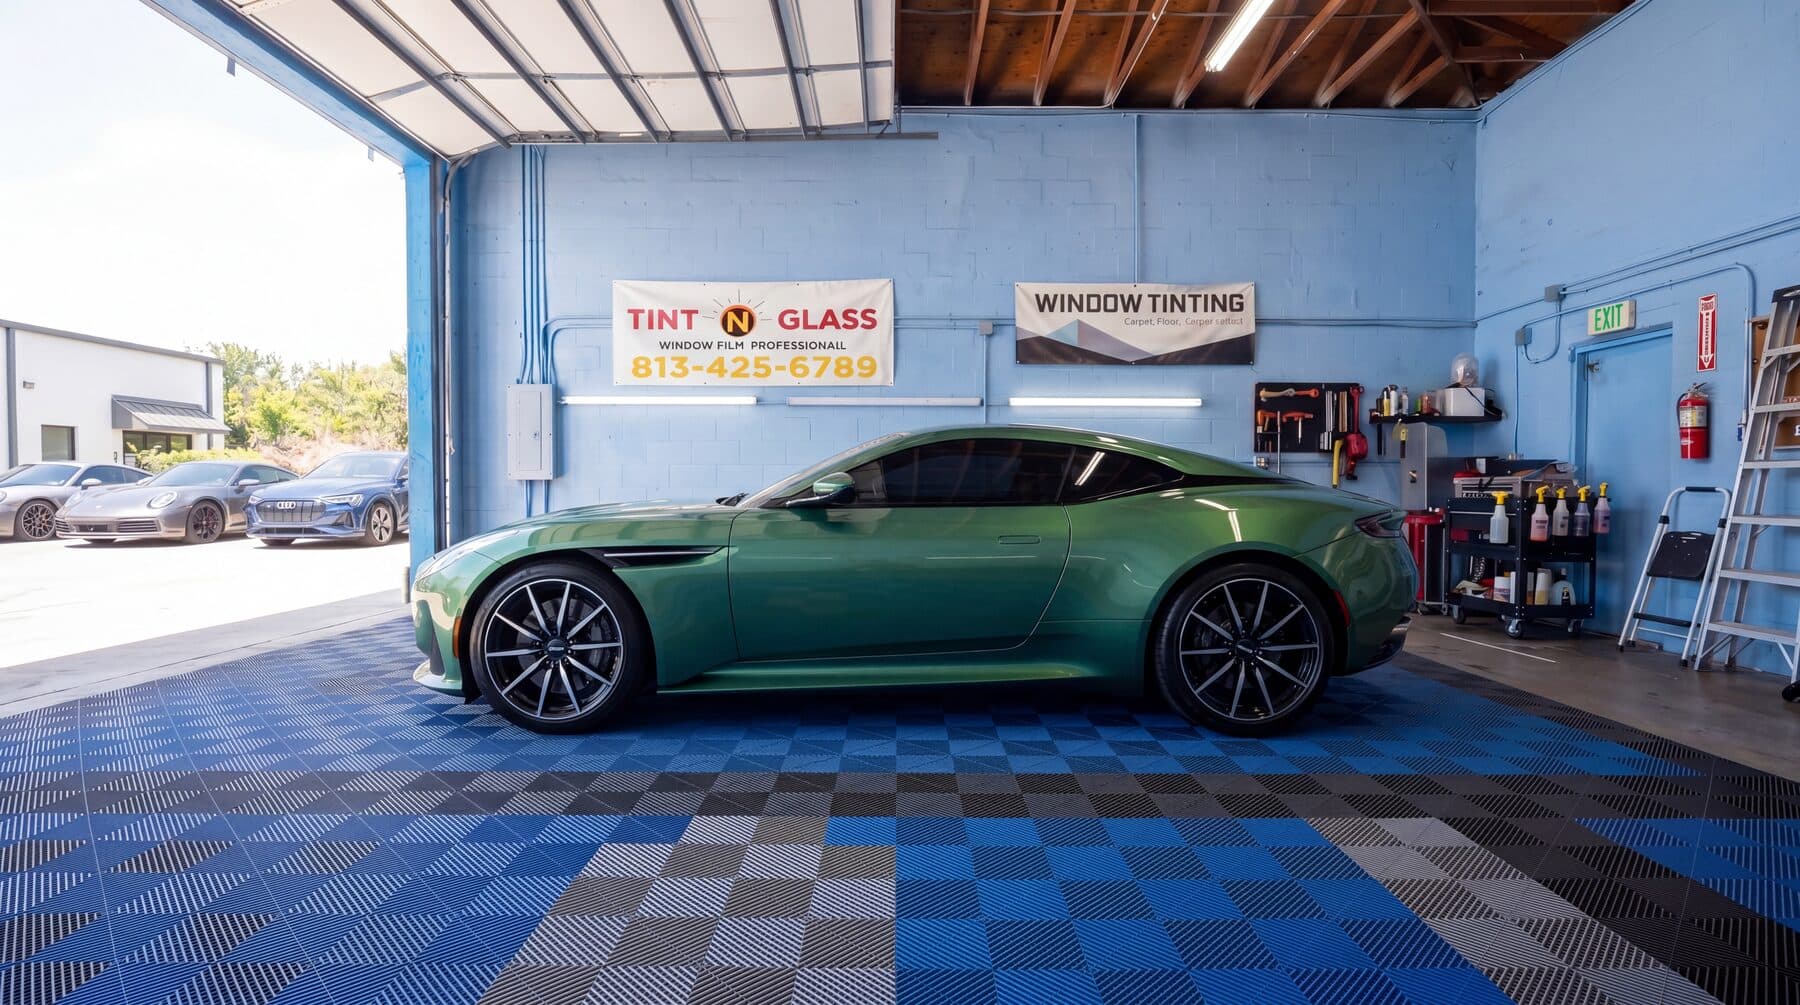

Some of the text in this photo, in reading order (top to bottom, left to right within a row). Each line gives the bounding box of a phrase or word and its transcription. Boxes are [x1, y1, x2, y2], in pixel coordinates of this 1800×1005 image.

[1035, 293, 1245, 313] WINDOW TINTING
[627, 308, 878, 333] TINT N GLASS
[1124, 317, 1155, 327] Carpet,
[1157, 317, 1181, 327] Floor,
[1595, 303, 1623, 331] EXIT
[659, 341, 712, 350] WINDOW
[717, 341, 744, 350] FILM
[631, 356, 877, 379] 813-425-6789
